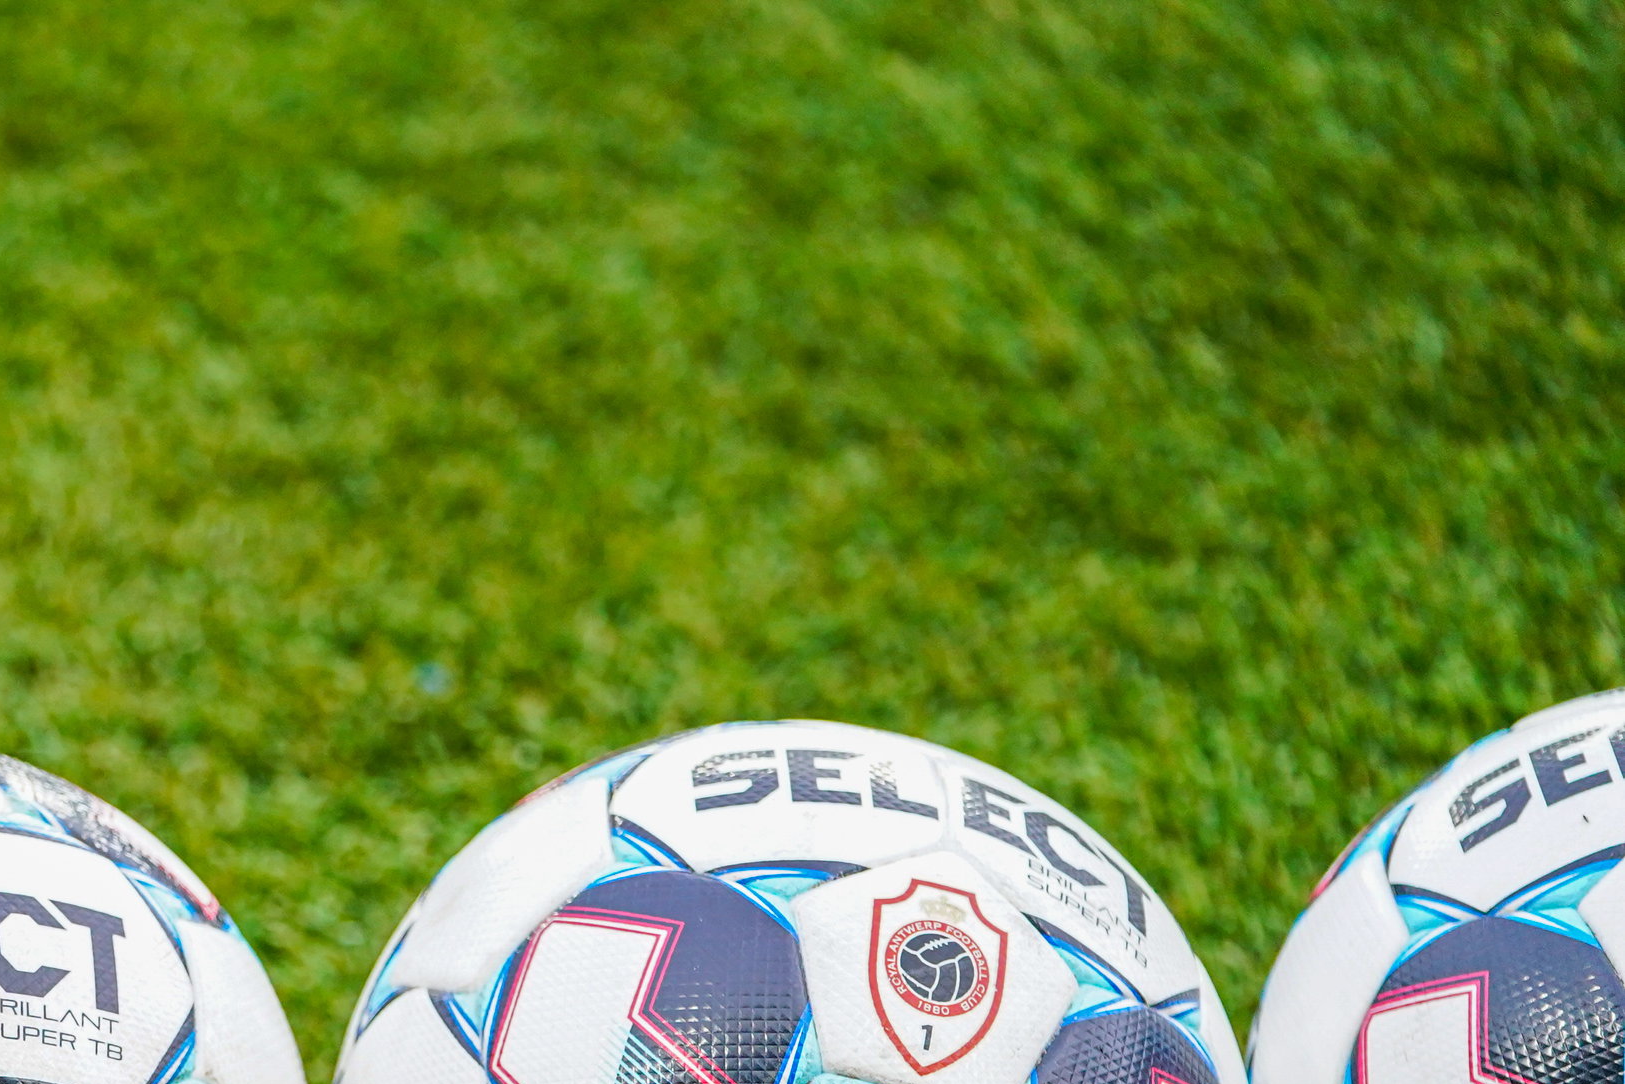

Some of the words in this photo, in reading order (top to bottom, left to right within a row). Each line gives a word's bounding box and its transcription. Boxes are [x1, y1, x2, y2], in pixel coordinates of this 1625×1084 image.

[691, 748, 1151, 937] SELECT
[1028, 858, 1147, 946] BRILLANT
[888, 921, 942, 951] ANTWERP
[1027, 873, 1111, 936] SUPER
[1120, 933, 1148, 969] TB
[945, 925, 988, 981] FOOTBALL
[886, 953, 907, 995] ROYAL
[917, 999, 951, 1016] 1880
[960, 983, 986, 1012] CLUB
[87, 1037, 123, 1061] TB
[921, 1024, 933, 1051] 1
